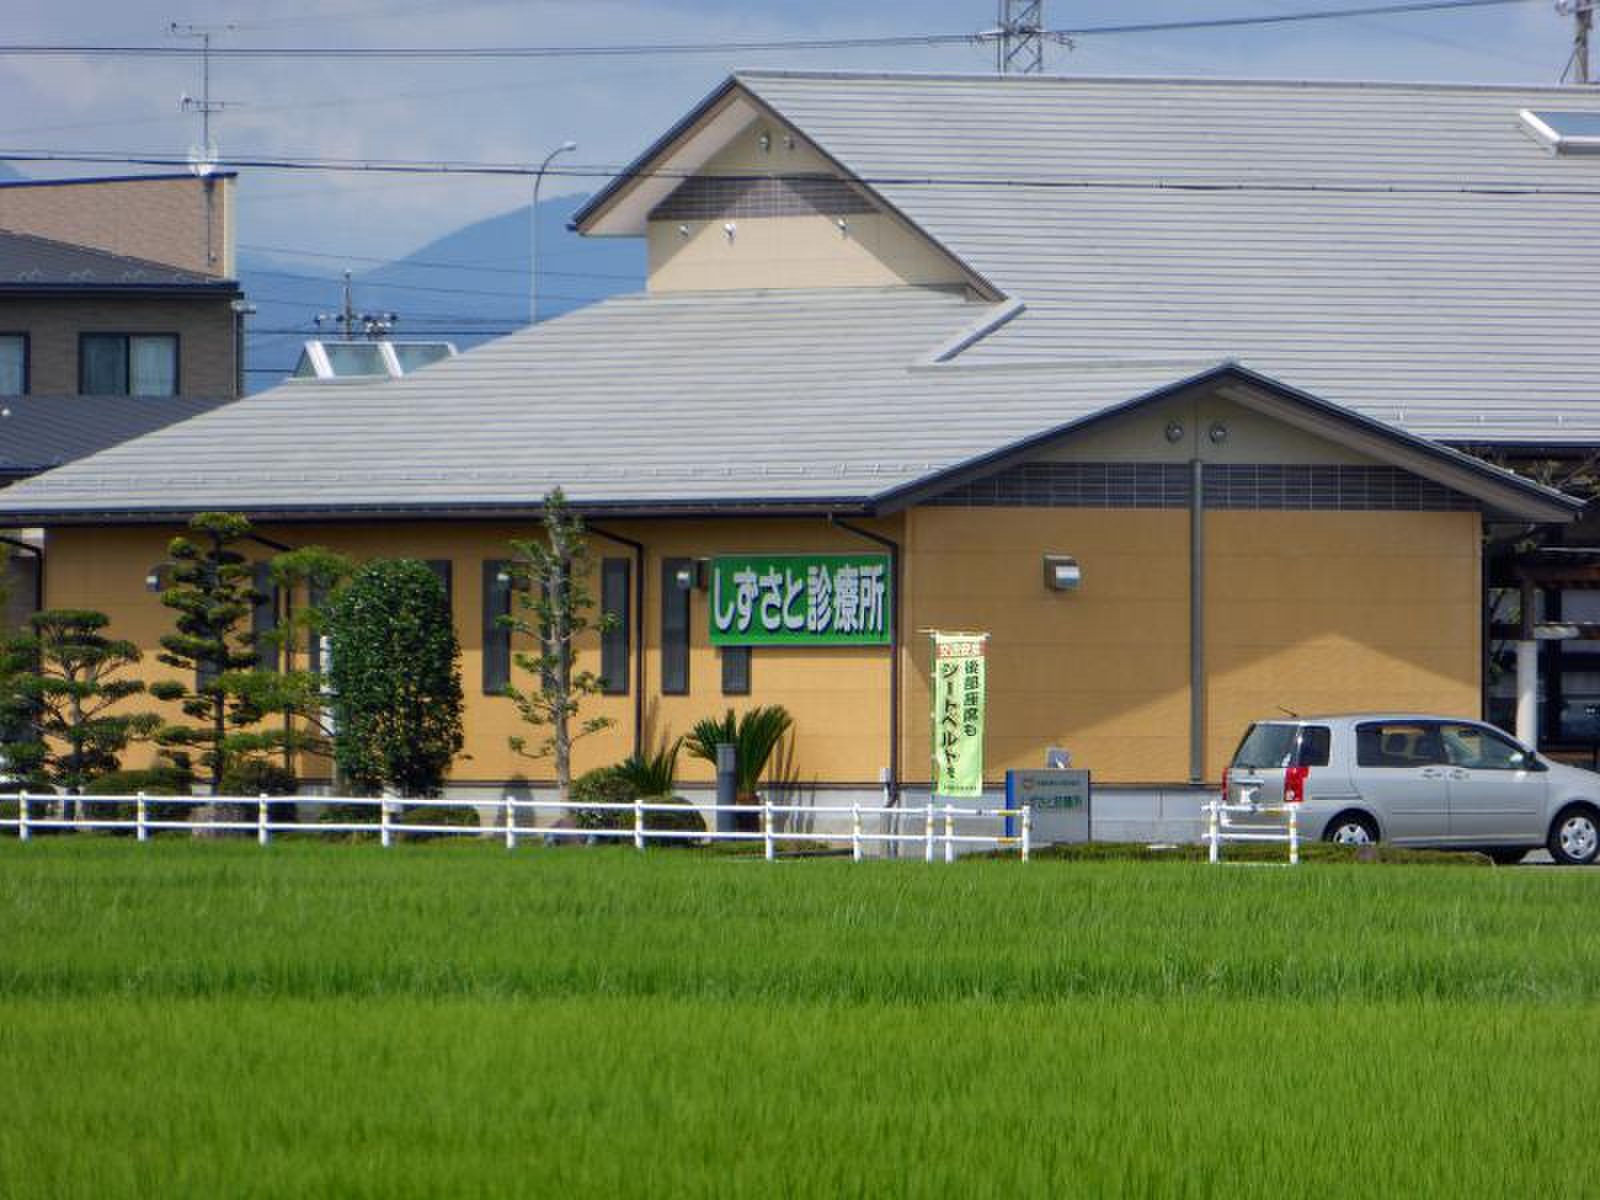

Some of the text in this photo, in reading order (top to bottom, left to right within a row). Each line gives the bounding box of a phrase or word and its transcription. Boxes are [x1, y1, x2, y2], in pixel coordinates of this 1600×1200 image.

[714, 564, 885, 632] しずさと診療所
